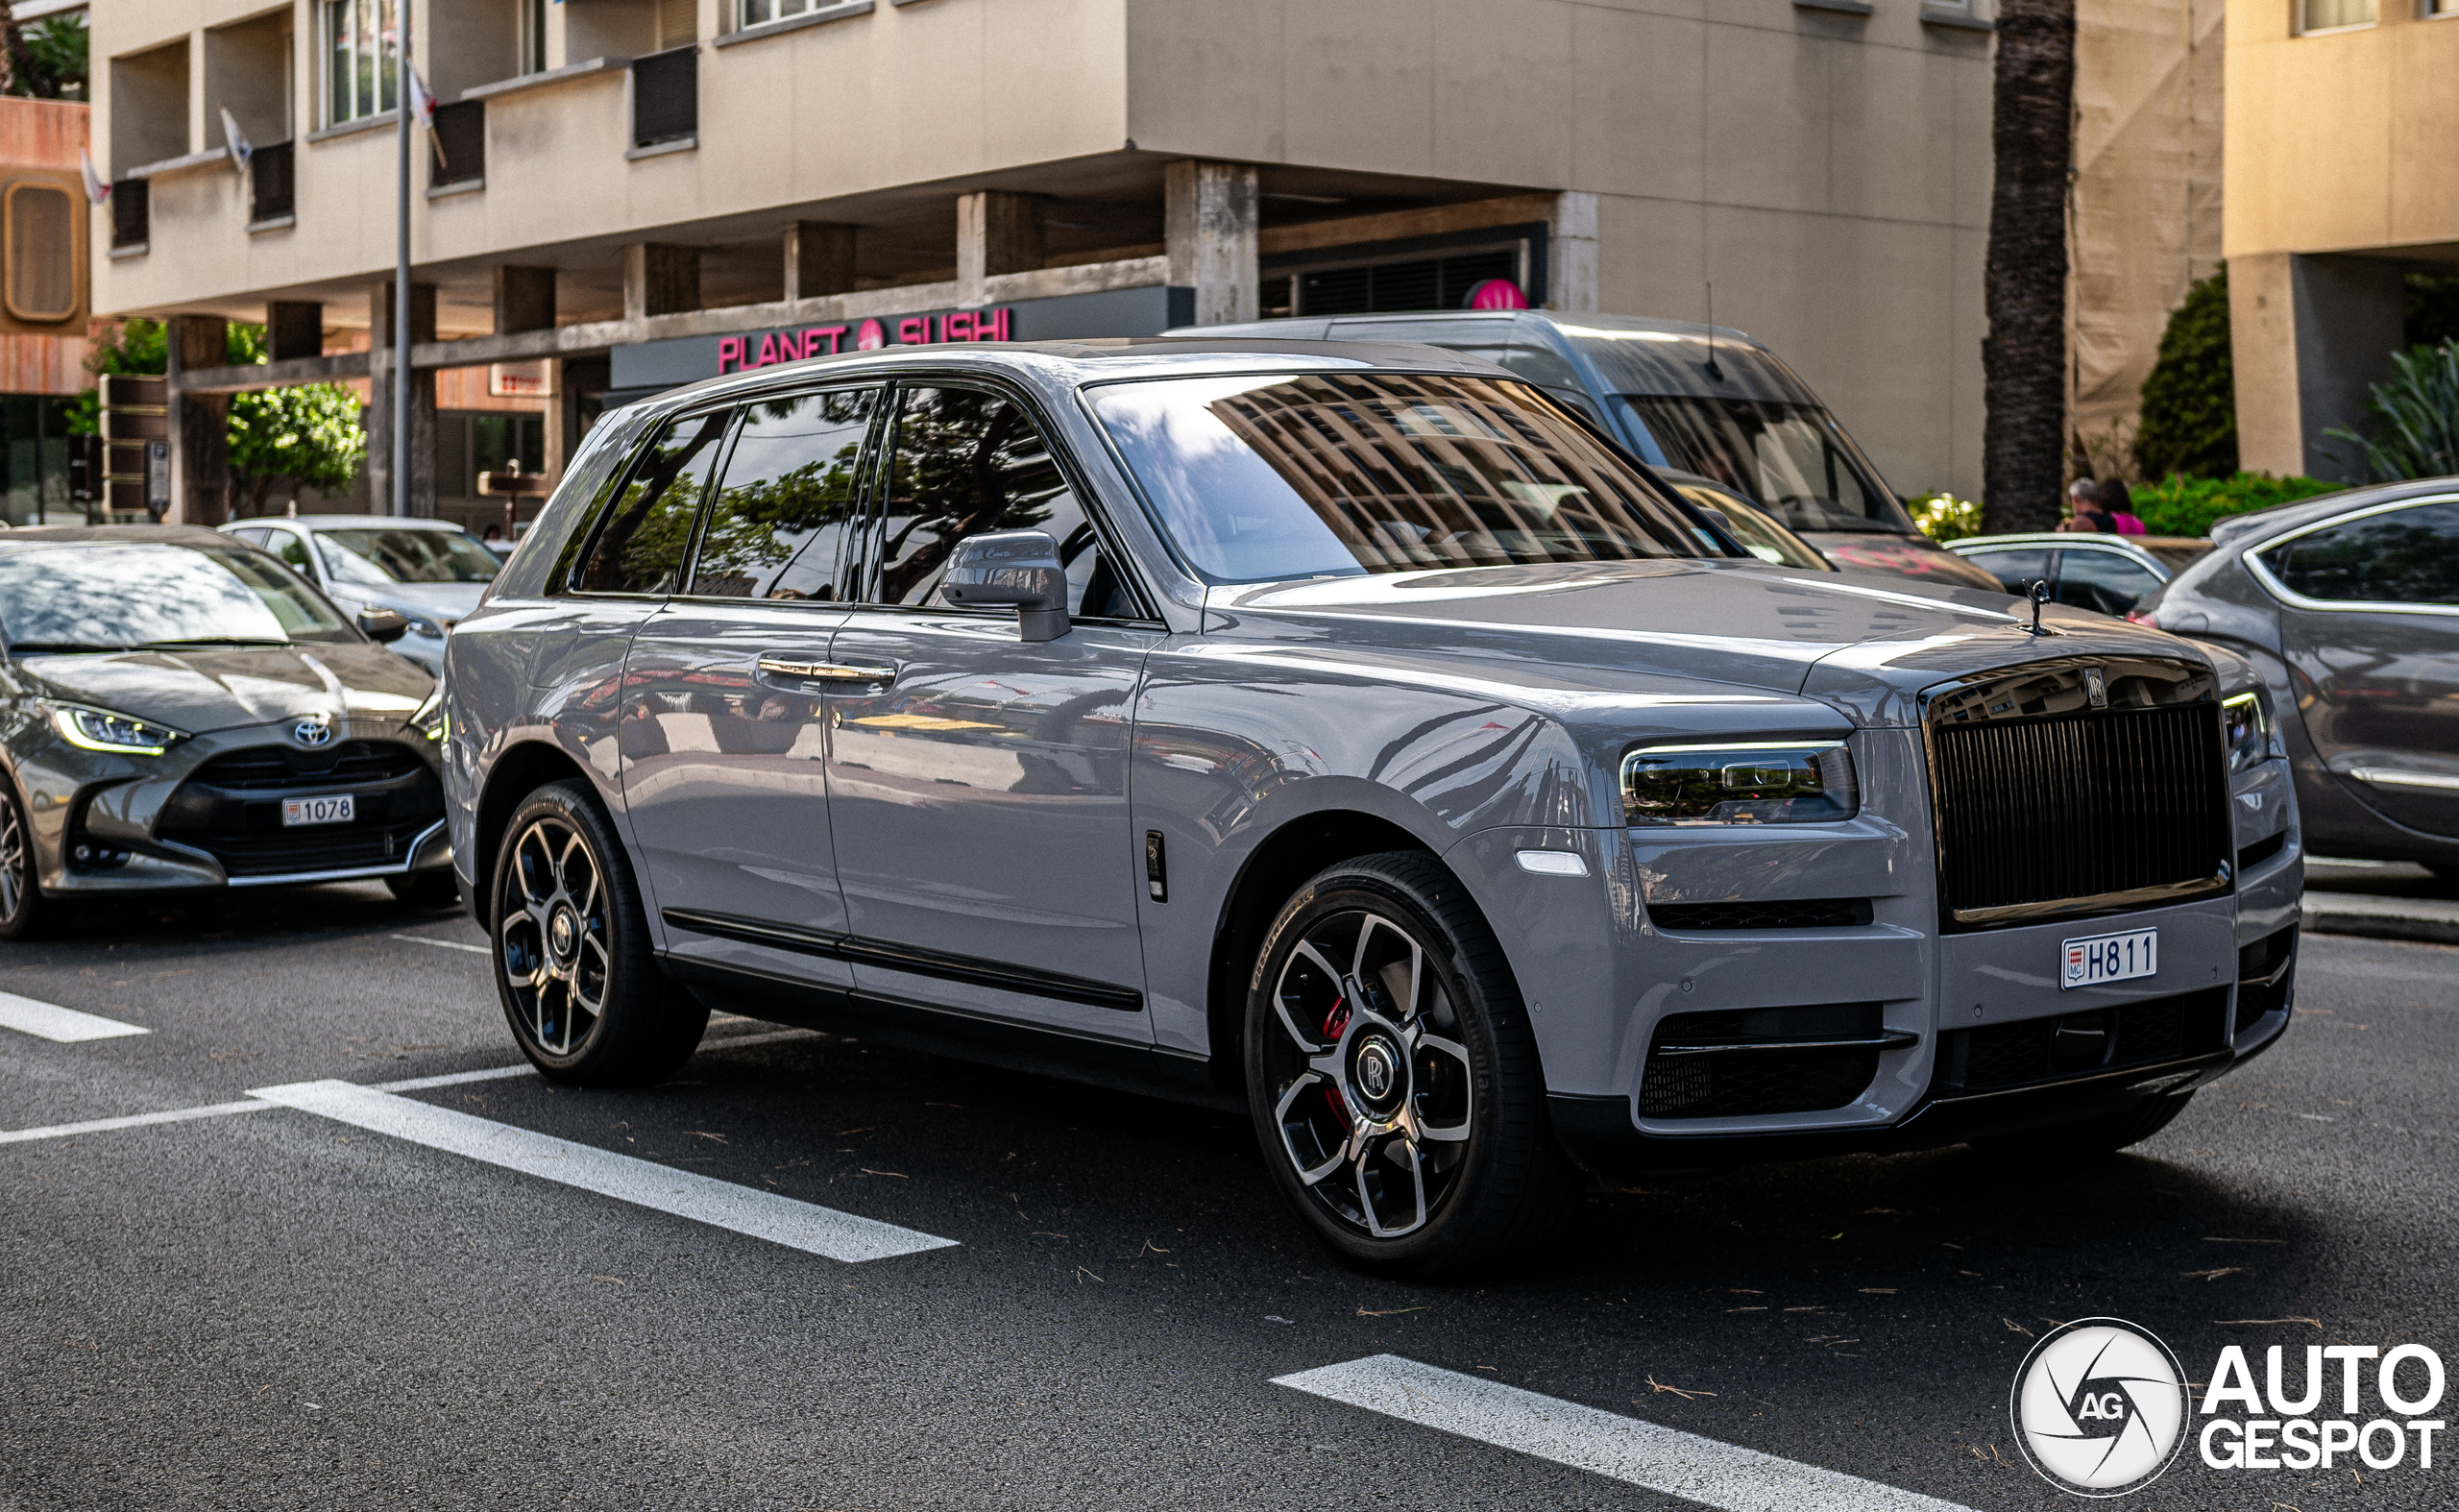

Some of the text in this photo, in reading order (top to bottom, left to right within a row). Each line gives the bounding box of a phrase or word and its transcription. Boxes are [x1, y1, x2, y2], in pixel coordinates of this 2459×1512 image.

[718, 307, 1009, 375] PLANET SUSHI
[305, 800, 351, 821] 1078
[2070, 963, 2082, 975] MC
[2088, 936, 2151, 980] H811
